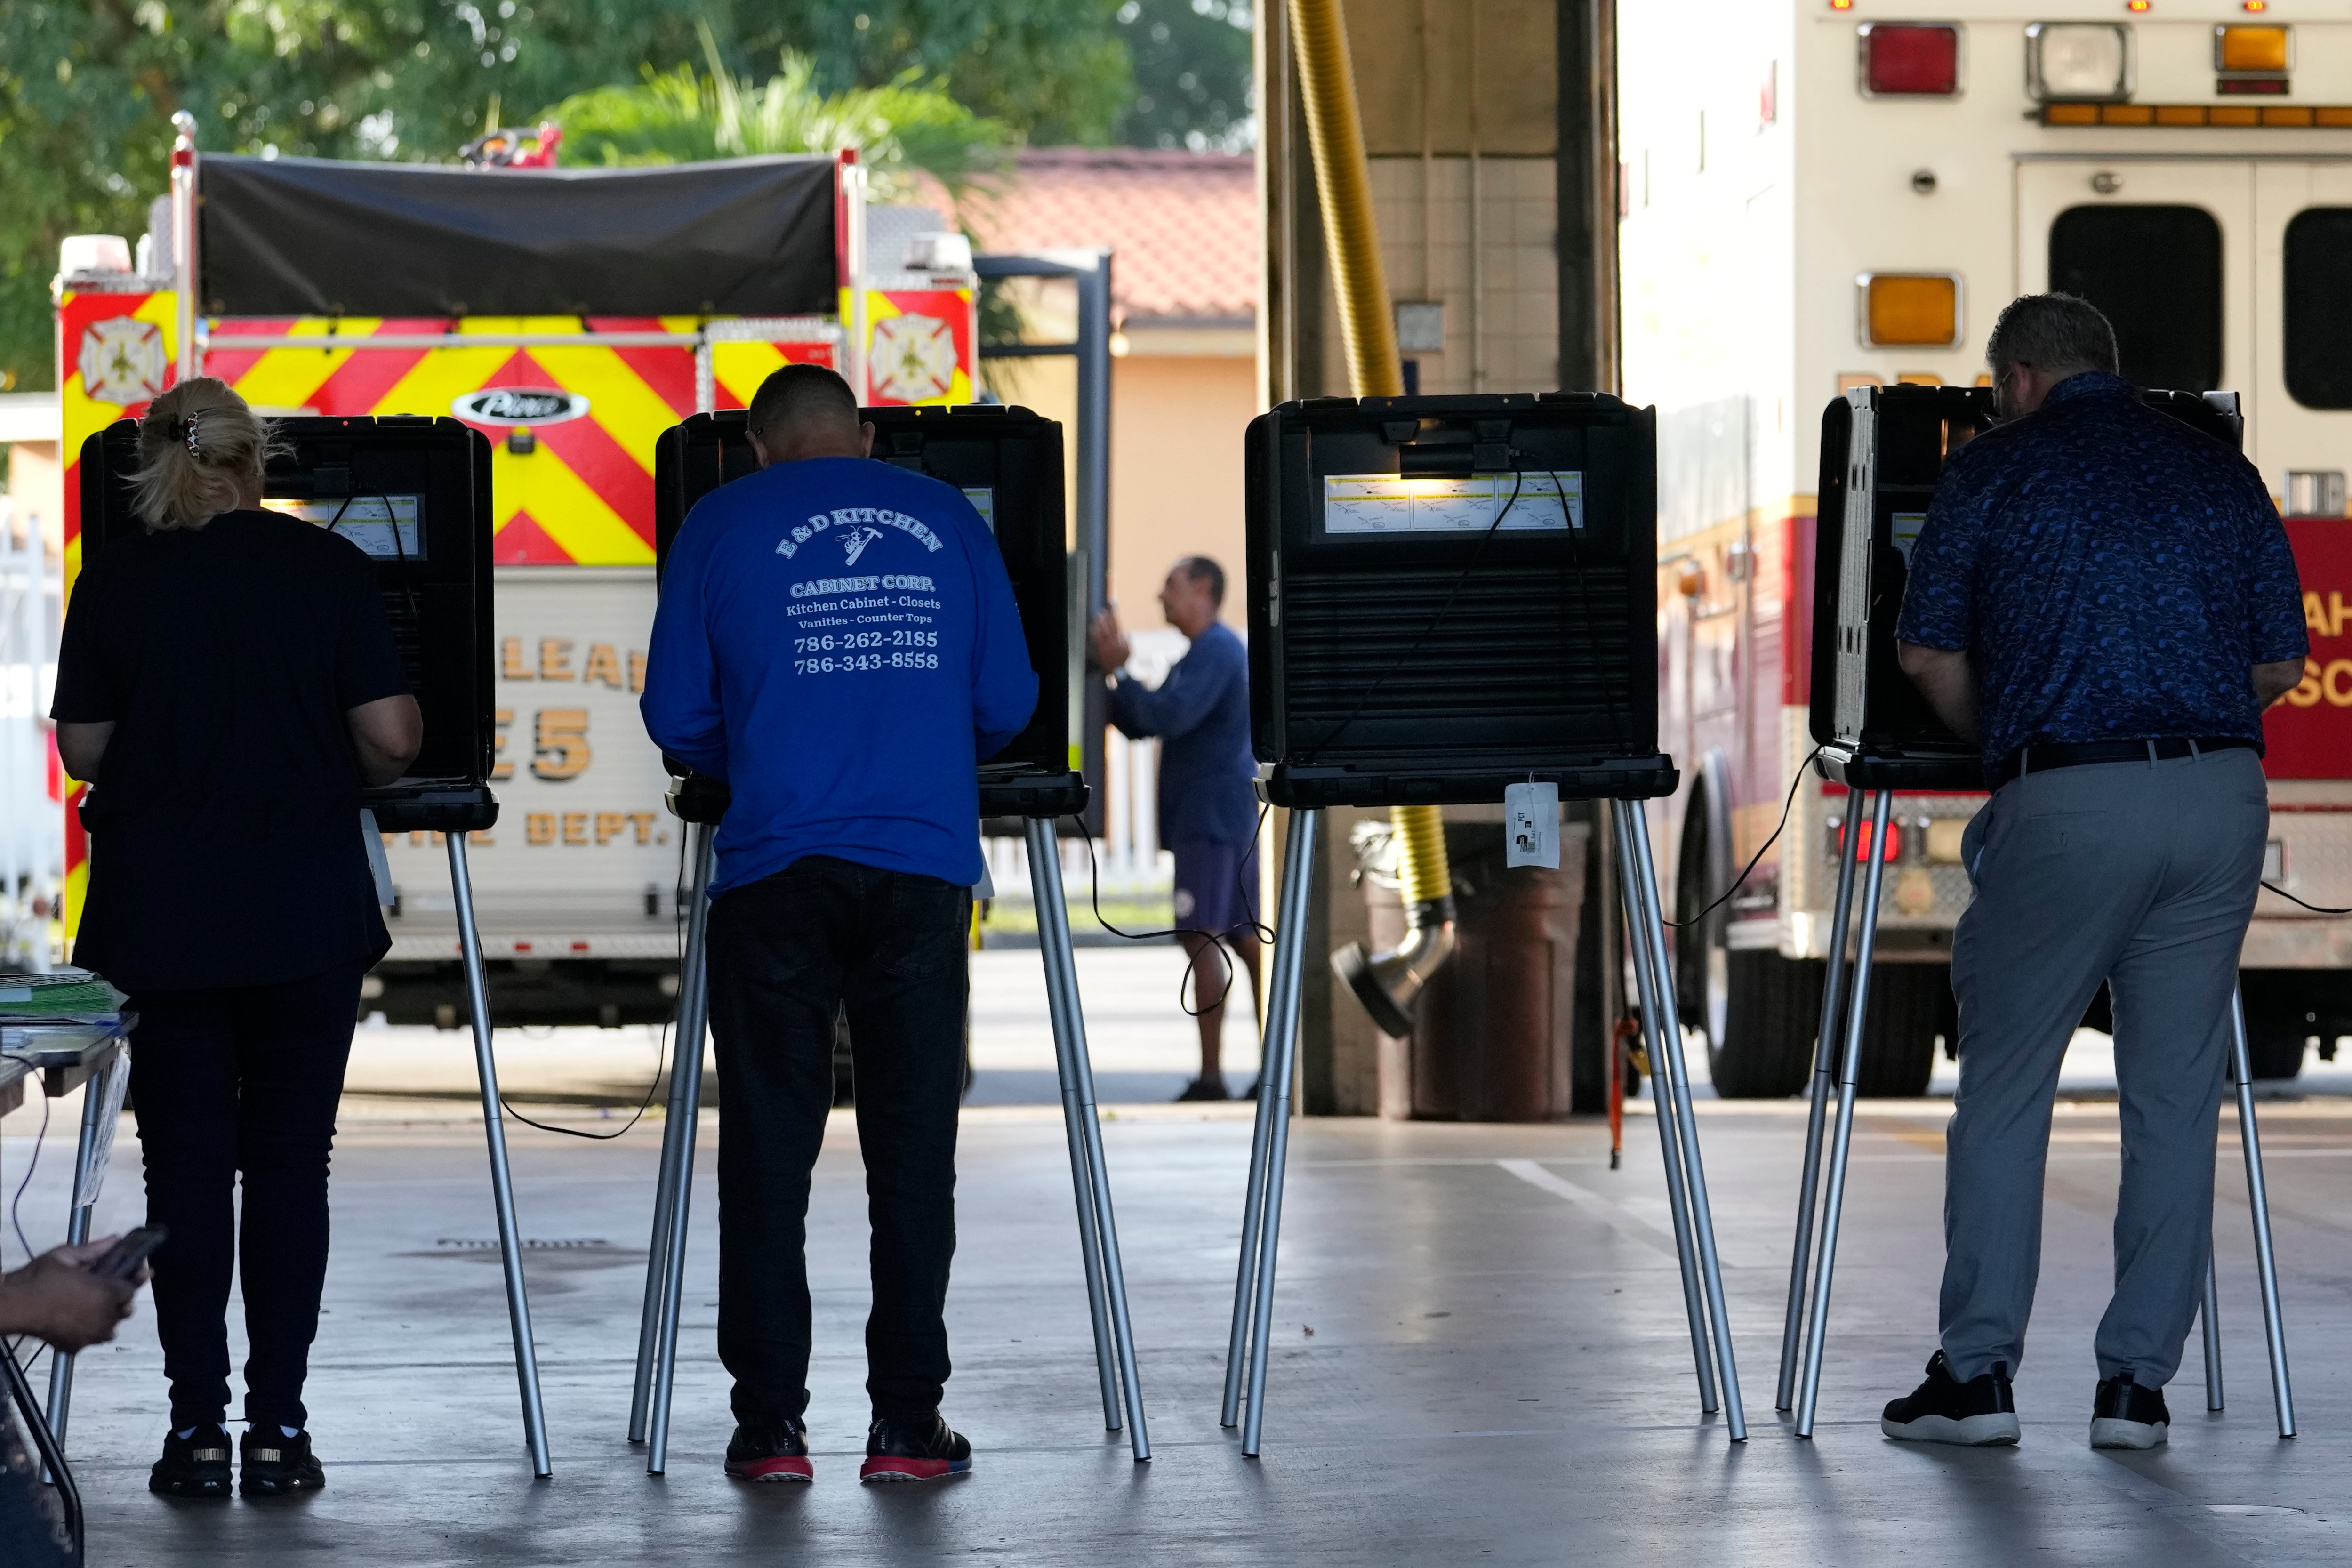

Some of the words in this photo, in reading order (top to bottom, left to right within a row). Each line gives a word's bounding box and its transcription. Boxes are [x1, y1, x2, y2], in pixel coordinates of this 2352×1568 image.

[775, 539, 797, 559] E
[791, 525, 812, 543] &
[809, 515, 830, 532] D
[830, 508, 943, 552] KITCHEN
[790, 576, 880, 598] CABINET
[881, 575, 936, 592] CORP.
[787, 601, 838, 616] Kitchen
[840, 596, 889, 610] Cabinet
[899, 596, 941, 610] Closets
[798, 617, 848, 629] Vanities
[857, 613, 904, 624] Counter
[906, 614, 932, 624] Tops
[794, 631, 938, 653] 786-262-2185
[795, 652, 938, 675] 786-343-8558
[2274, 658, 2352, 707] SC
[526, 812, 667, 846] DEPT.
[193, 1448, 225, 1461] PUMA
[249, 1448, 280, 1462] PUMA
